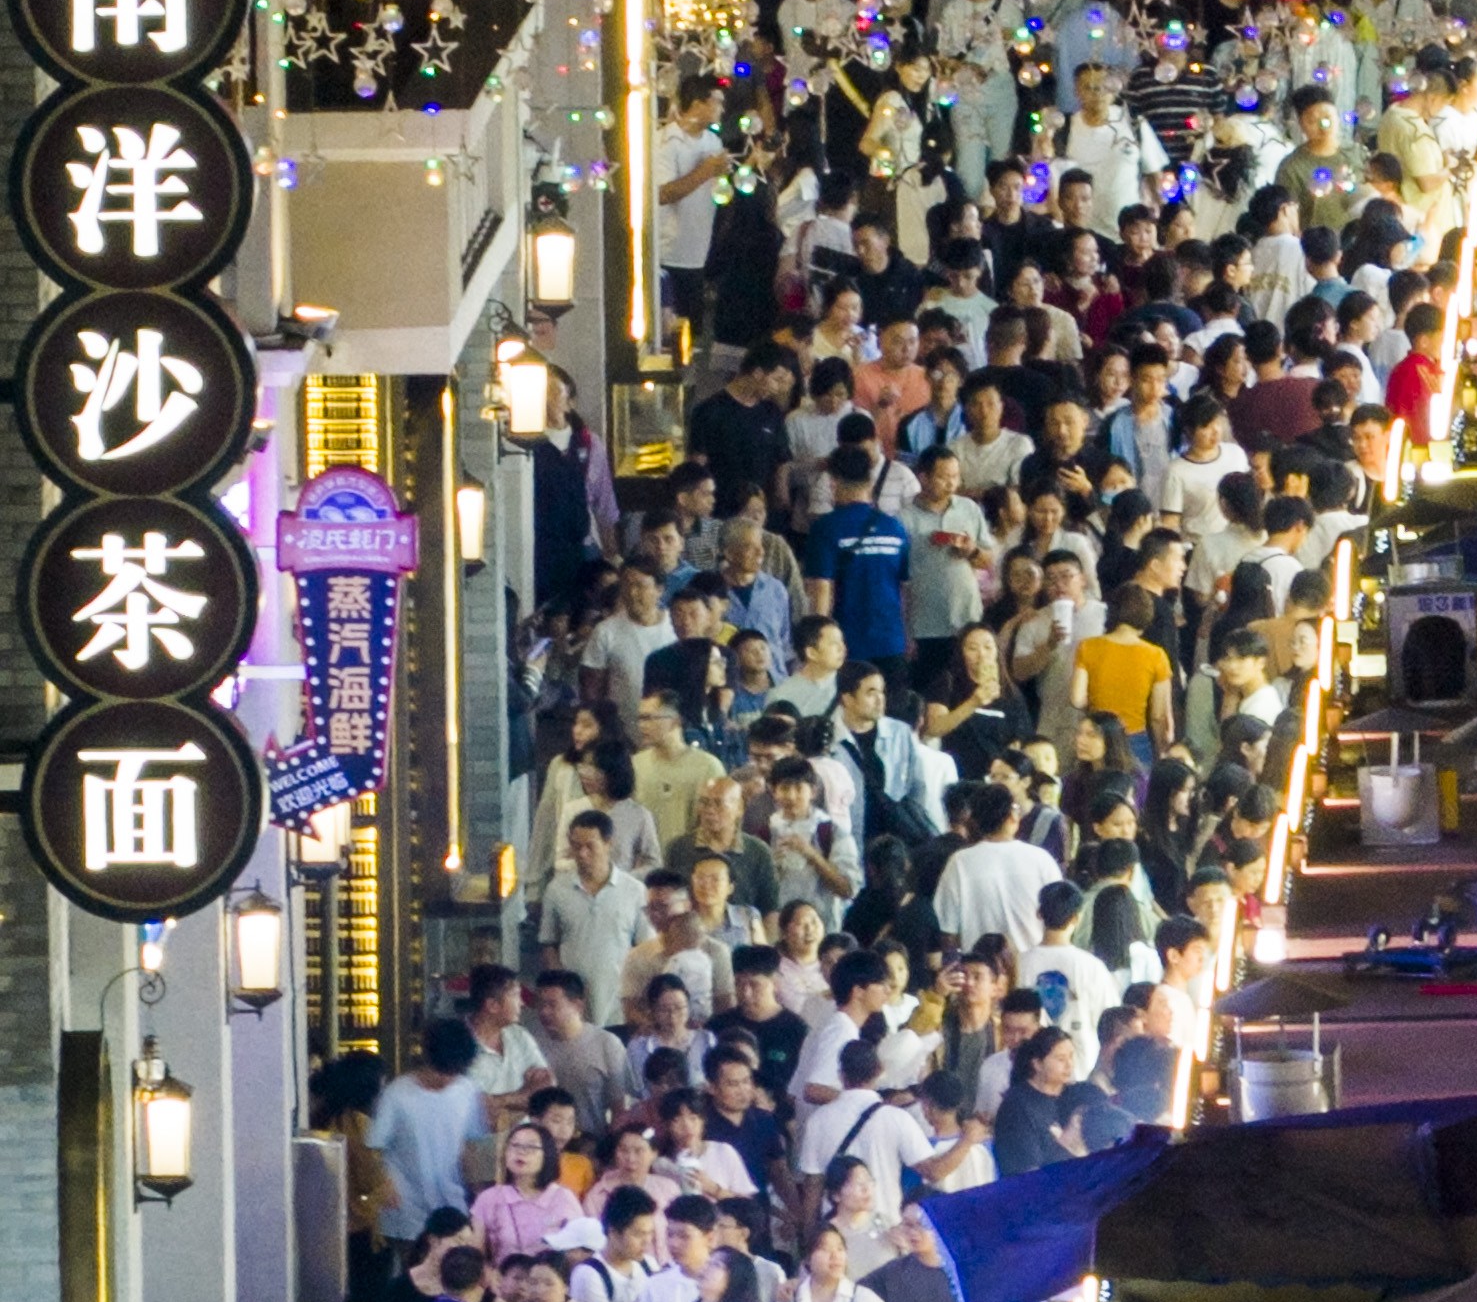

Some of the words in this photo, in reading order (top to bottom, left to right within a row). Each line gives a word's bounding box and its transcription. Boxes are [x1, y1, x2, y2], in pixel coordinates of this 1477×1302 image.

[326, 575, 374, 756] 蒸汽海鲜
[270, 754, 340, 794] WELCOME
